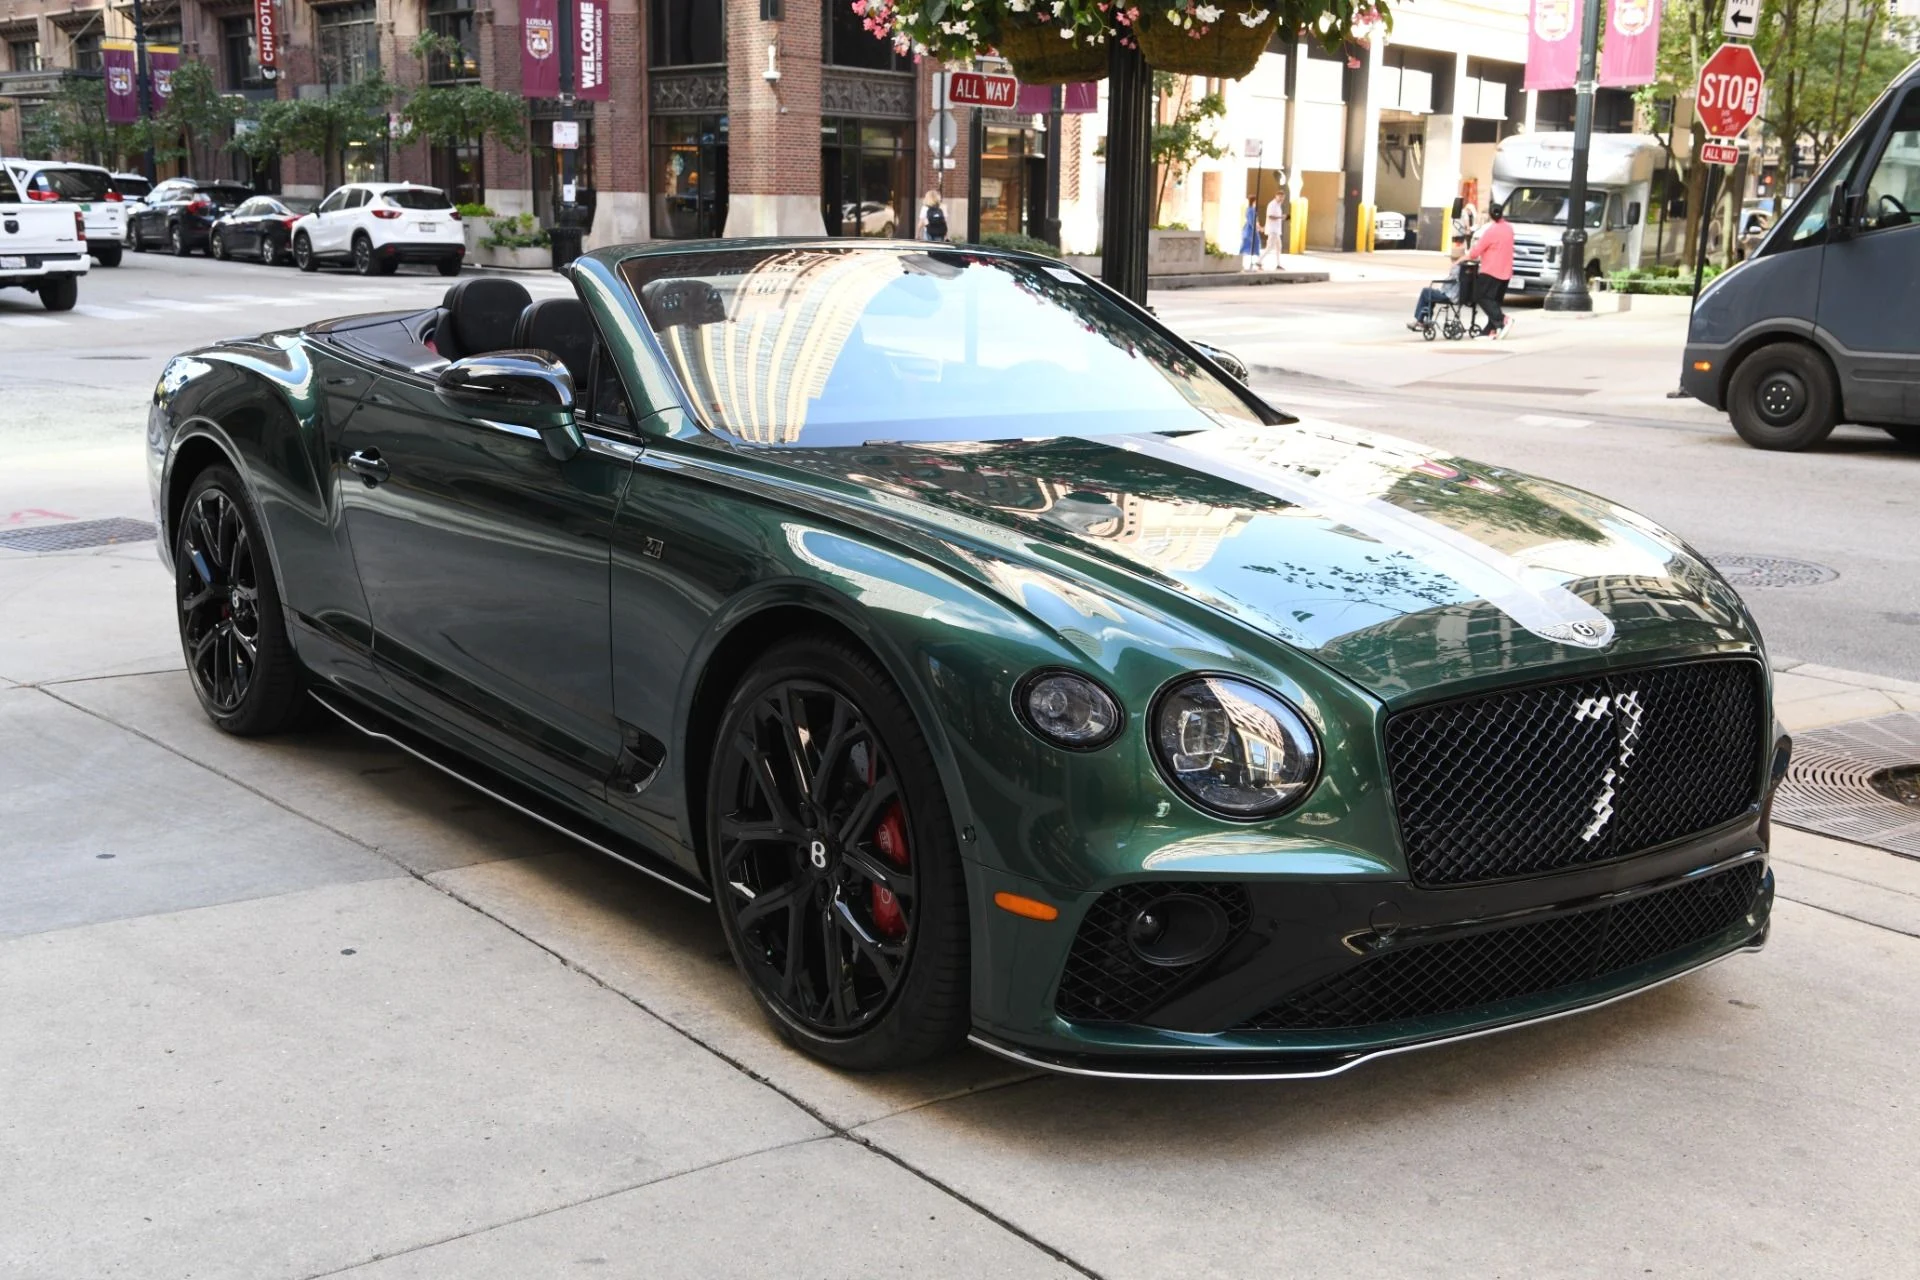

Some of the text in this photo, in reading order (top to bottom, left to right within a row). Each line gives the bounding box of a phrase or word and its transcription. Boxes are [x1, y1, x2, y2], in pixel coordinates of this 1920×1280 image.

[526, 18, 552, 26] LOYOLA
[580, 2, 595, 89] WELCOME
[955, 78, 1011, 102] ALL WAY
[1701, 73, 1758, 111] STOP
[1525, 156, 1551, 169] The
[1705, 147, 1736, 161] ALL WAY
[811, 841, 826, 868] B
